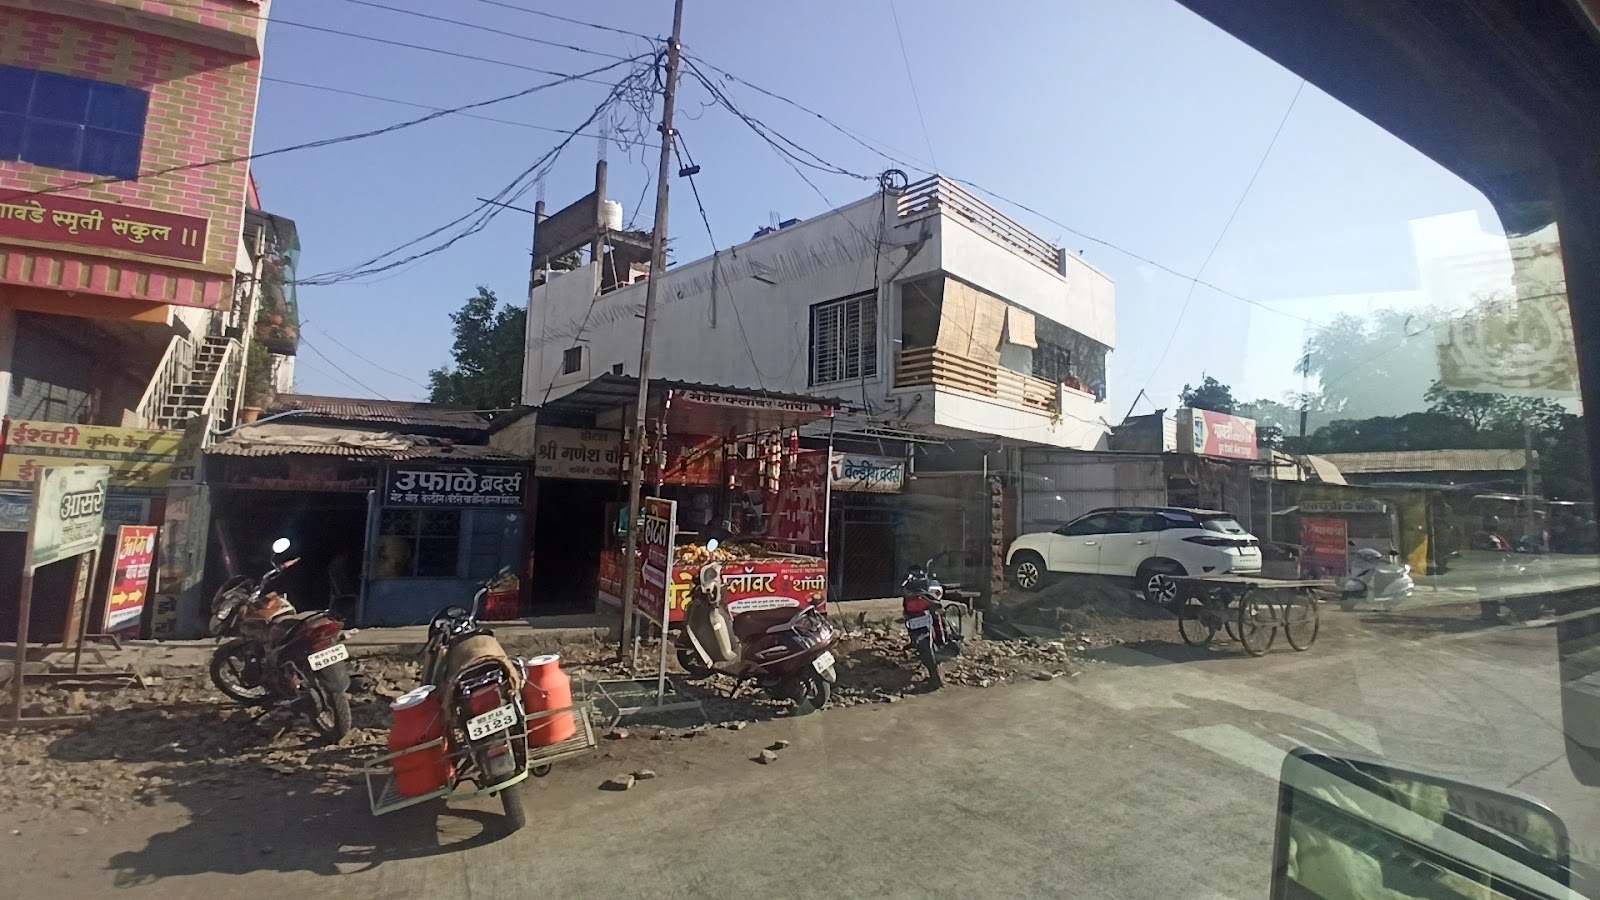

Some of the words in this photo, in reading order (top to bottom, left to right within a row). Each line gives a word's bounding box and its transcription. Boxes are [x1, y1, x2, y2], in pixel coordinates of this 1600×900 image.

[52, 209, 103, 234] स्मृती
[112, 214, 171, 243] संकुल
[12, 422, 80, 446] ईश्वरी
[87, 433, 120, 449] कृषि
[538, 440, 557, 460] श्री
[561, 443, 602, 463] गणेश
[395, 467, 478, 492] उफाळे
[478, 471, 522, 494] ब्रदर्स
[60, 480, 104, 520] आसरे
[792, 574, 826, 592] शॉपी
[314, 652, 345, 669] 8907
[473, 714, 514, 737] 3123
